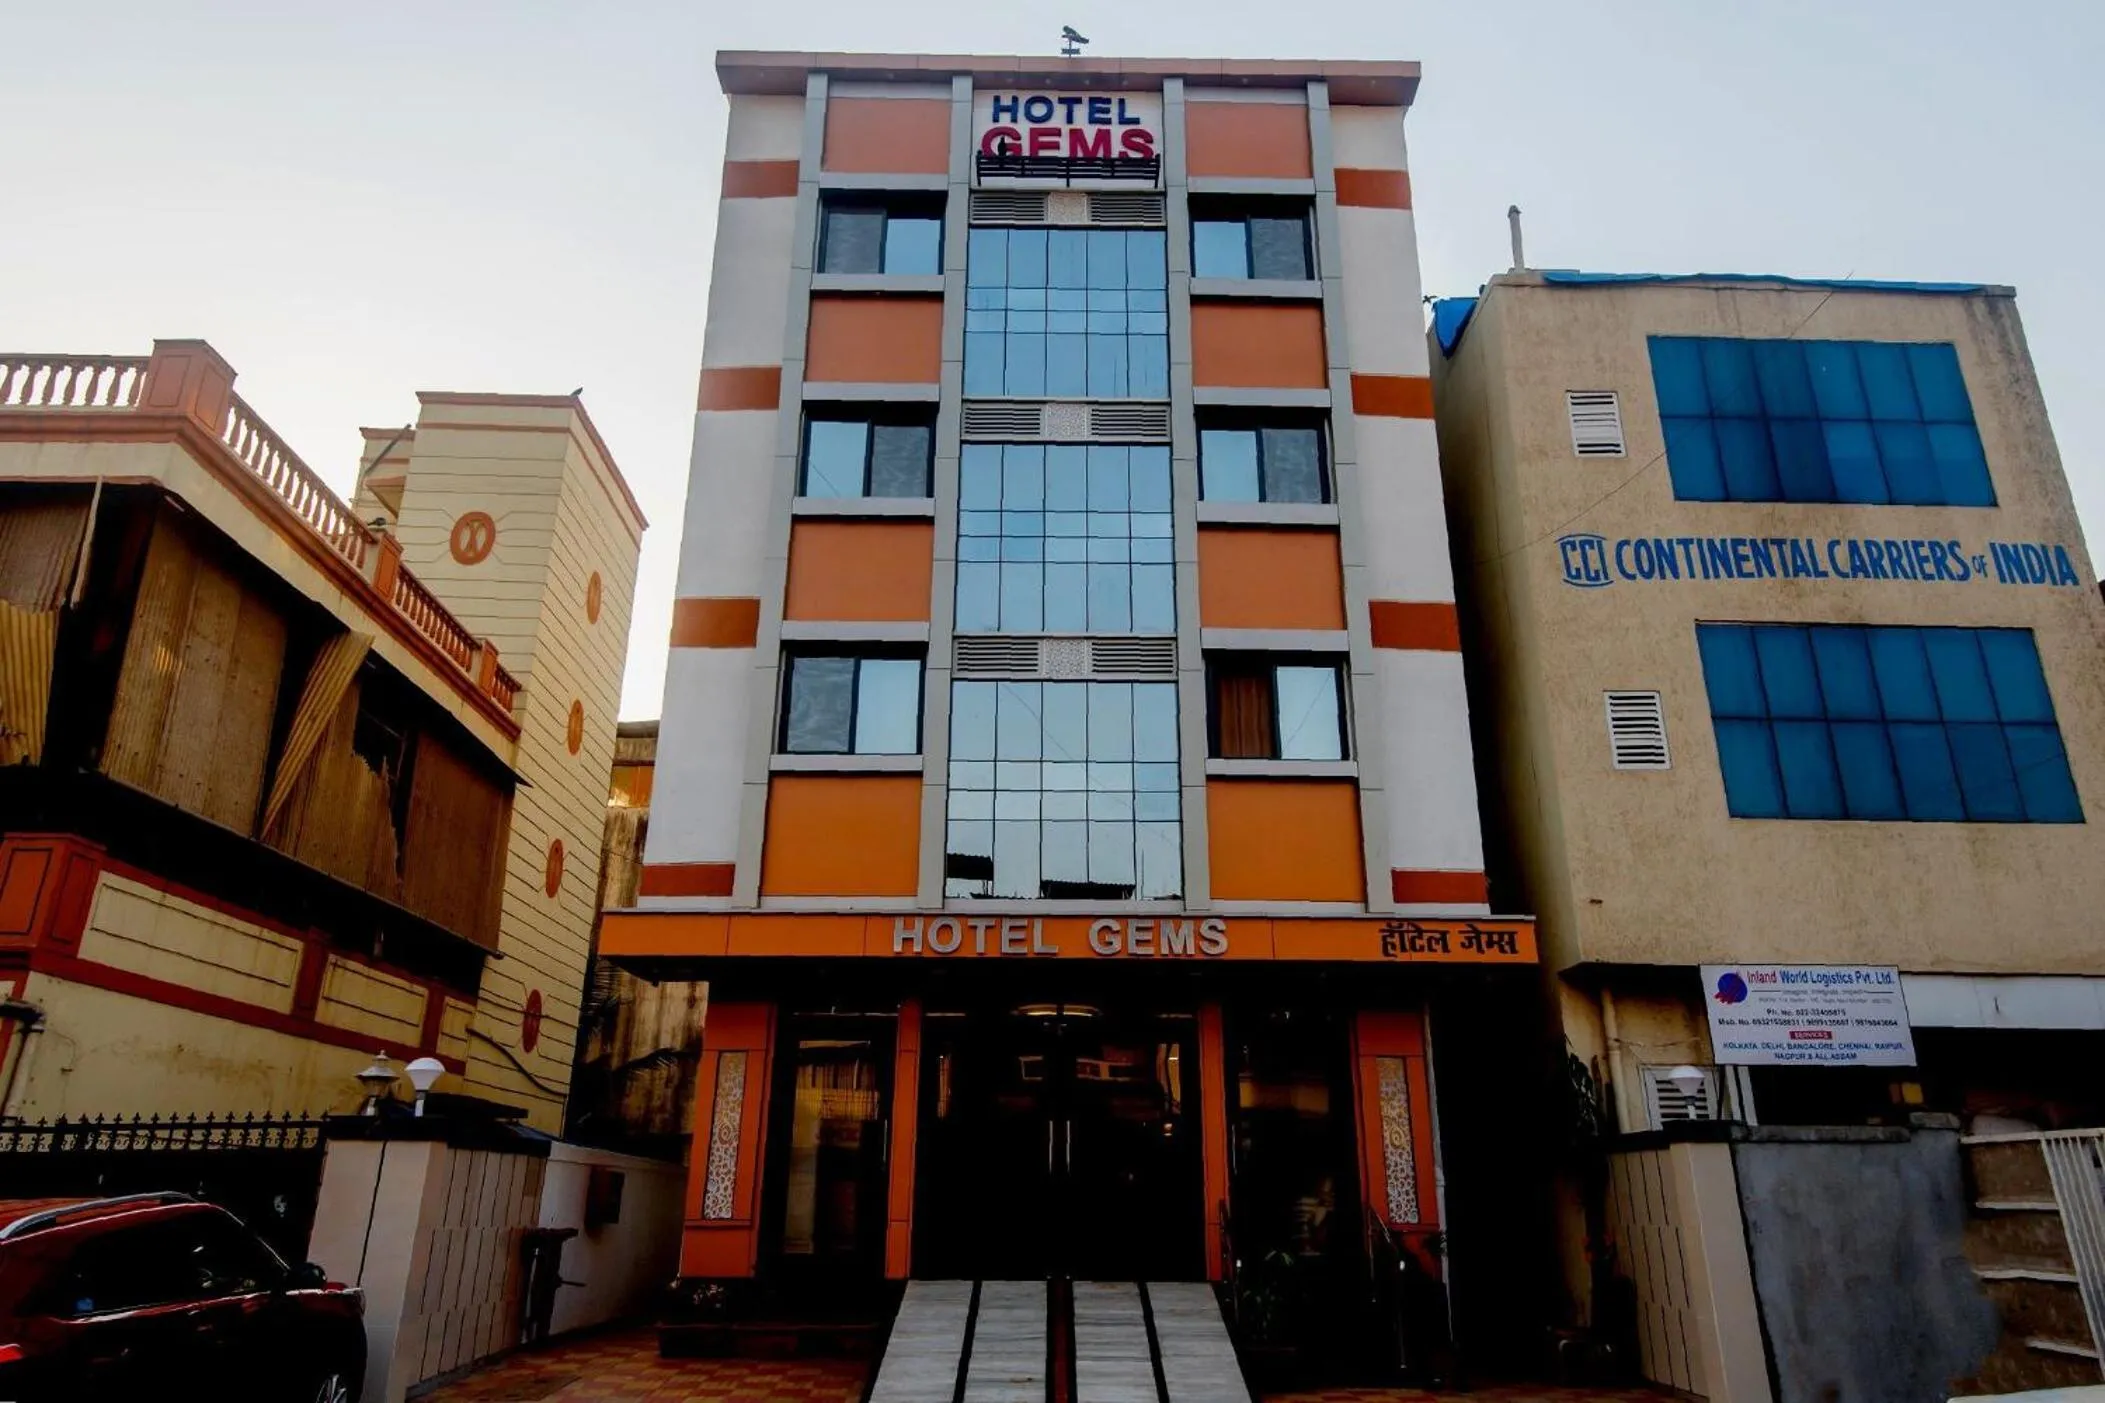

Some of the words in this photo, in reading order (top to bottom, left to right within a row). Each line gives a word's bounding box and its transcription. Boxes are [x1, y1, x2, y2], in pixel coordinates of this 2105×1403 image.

[992, 95, 1140, 125] HOTEL
[981, 126, 1156, 162] GEMS
[1560, 539, 1610, 582] CCI
[1615, 538, 1828, 580] CONTINENTAL
[1827, 539, 1971, 582] CARRIERS
[1972, 554, 1988, 578] OF
[1989, 541, 2080, 586] INDIA
[893, 916, 1059, 955] HOTEL
[1088, 918, 1229, 956] GEMS
[1458, 923, 1519, 955] जेम्स
[1747, 970, 1777, 984] Inland
[1779, 970, 1808, 985] World
[1811, 971, 1853, 987] Logistics
[1856, 971, 1873, 985] Pvt.
[1875, 971, 1895, 985] Ltd.
[1814, 1052, 1829, 1060] ALL
[1830, 1052, 1857, 1061] ASSAM
